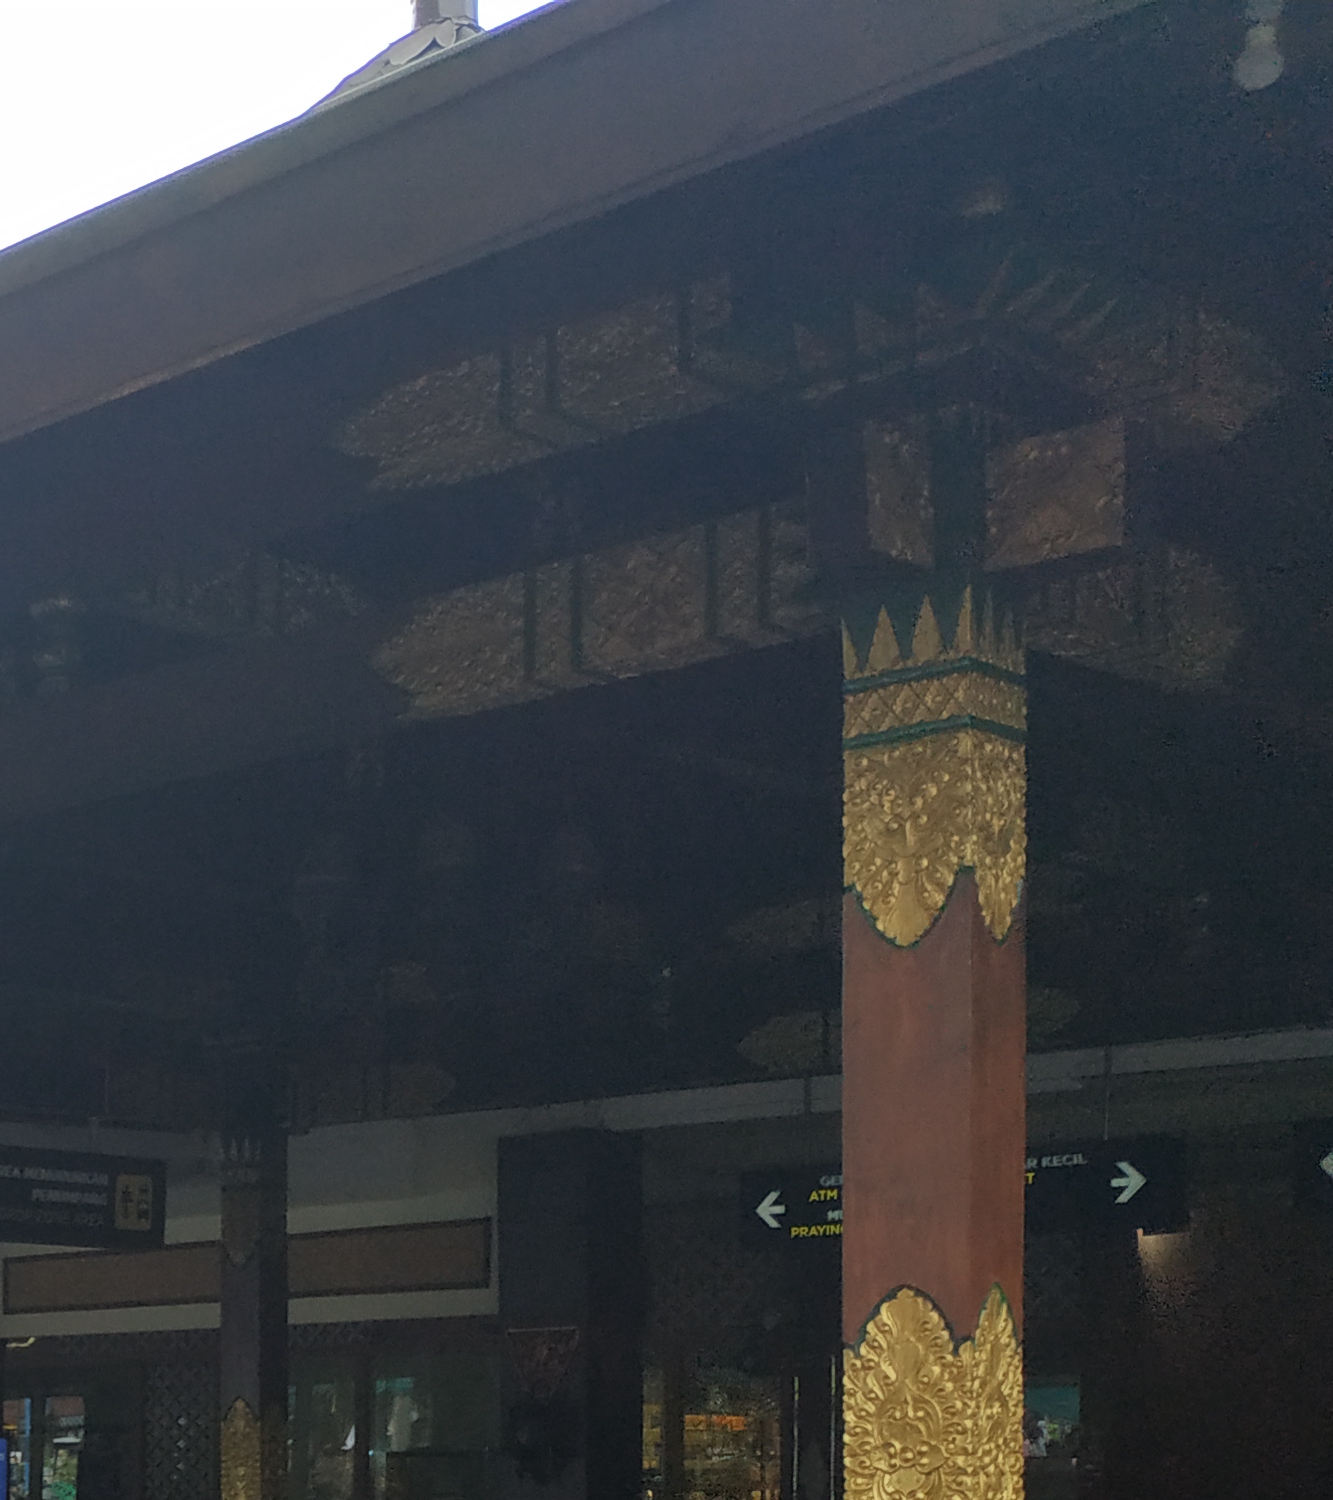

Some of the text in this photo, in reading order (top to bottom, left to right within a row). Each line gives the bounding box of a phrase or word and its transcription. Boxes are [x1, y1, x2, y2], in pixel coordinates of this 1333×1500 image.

[1041, 1153, 1088, 1168] KECIL
[808, 1188, 838, 1203] ATM
[790, 1223, 843, 1239] PRAYIN
